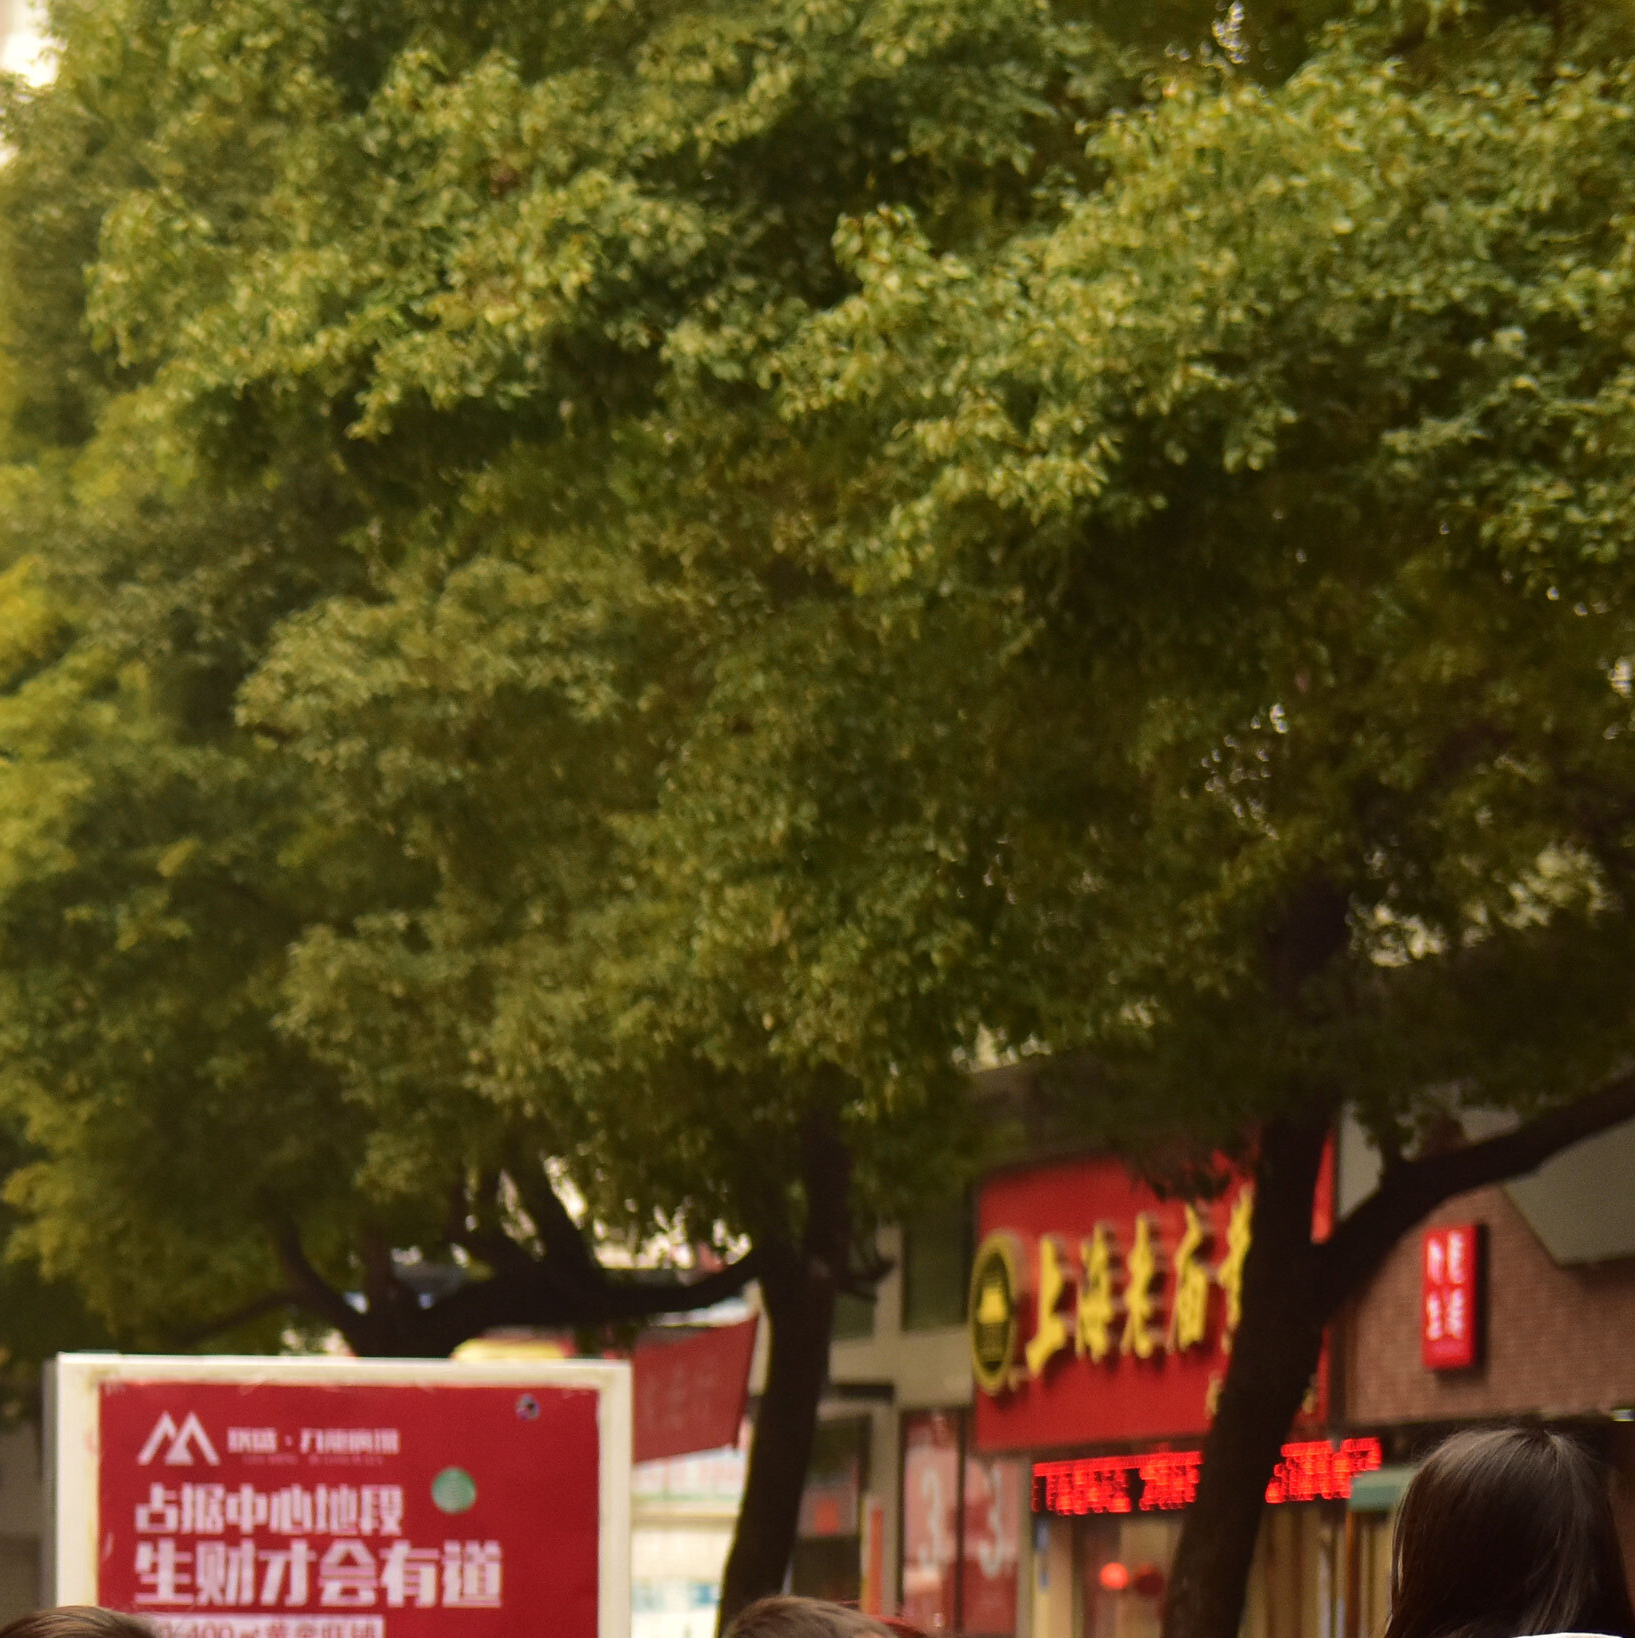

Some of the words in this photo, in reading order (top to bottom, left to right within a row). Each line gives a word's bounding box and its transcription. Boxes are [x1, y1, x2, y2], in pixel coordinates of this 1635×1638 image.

[135, 1482, 404, 1536] 占据中心地段
[134, 1540, 503, 1608] 生财才会有道
